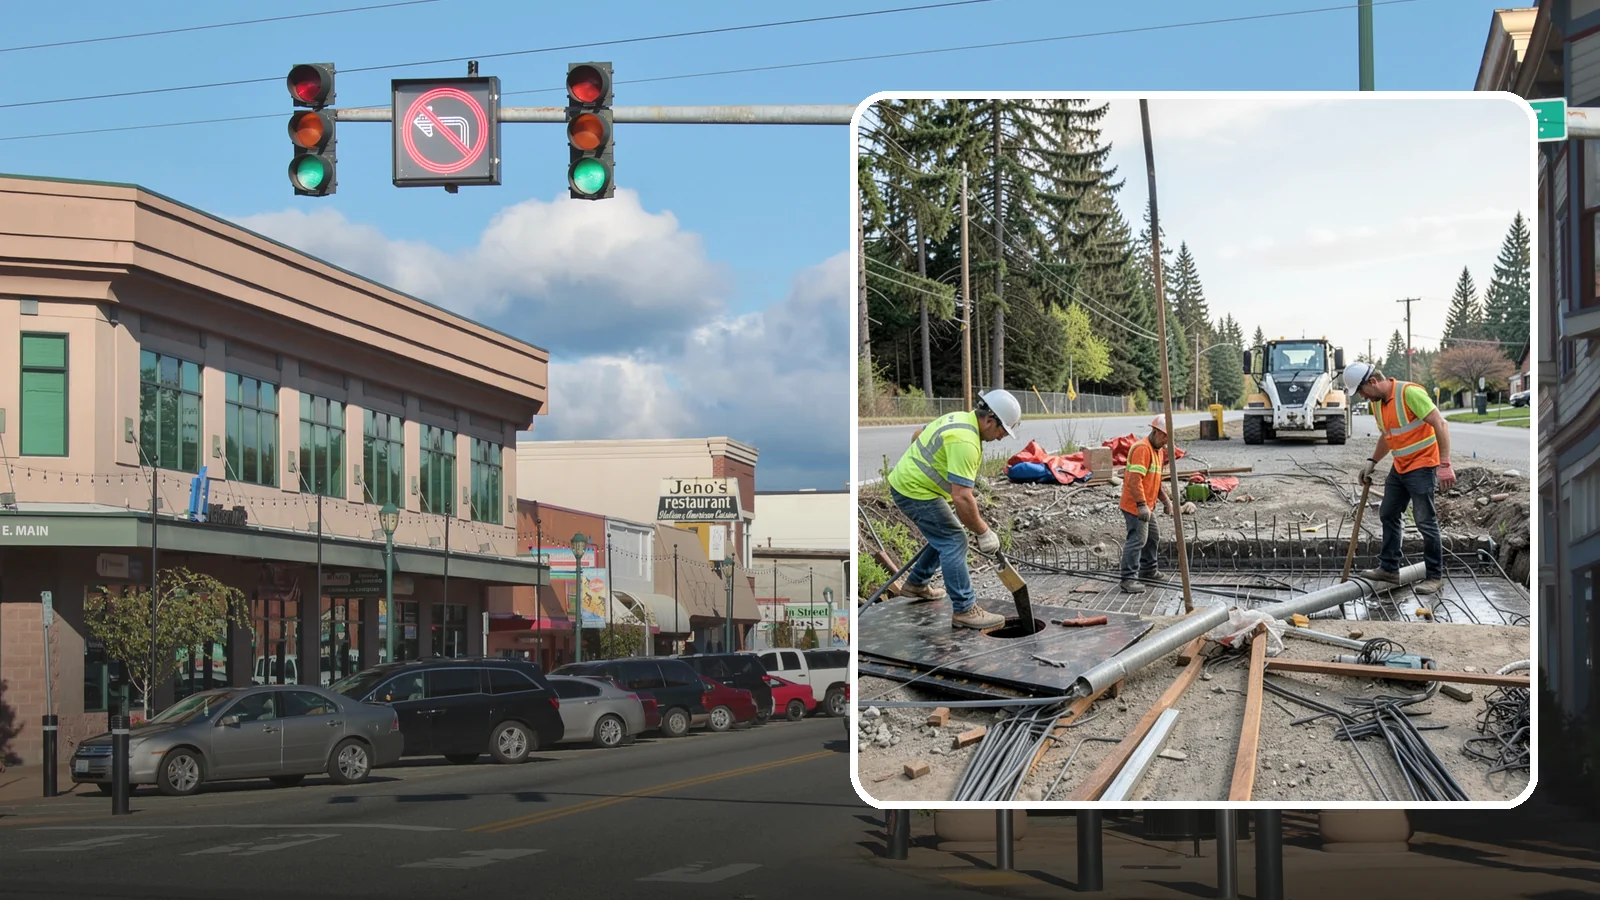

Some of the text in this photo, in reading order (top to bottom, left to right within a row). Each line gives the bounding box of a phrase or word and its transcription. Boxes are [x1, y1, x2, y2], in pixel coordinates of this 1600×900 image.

[670, 480, 727, 494] Jeno's
[665, 496, 731, 509] restaurant
[659, 509, 681, 519] Italian
[686, 509, 714, 519] American
[715, 509, 737, 519] Cuisine
[2, 525, 49, 536] E. MAIN
[785, 607, 794, 617] in
[797, 607, 828, 617] Street
[790, 619, 823, 627] lass
